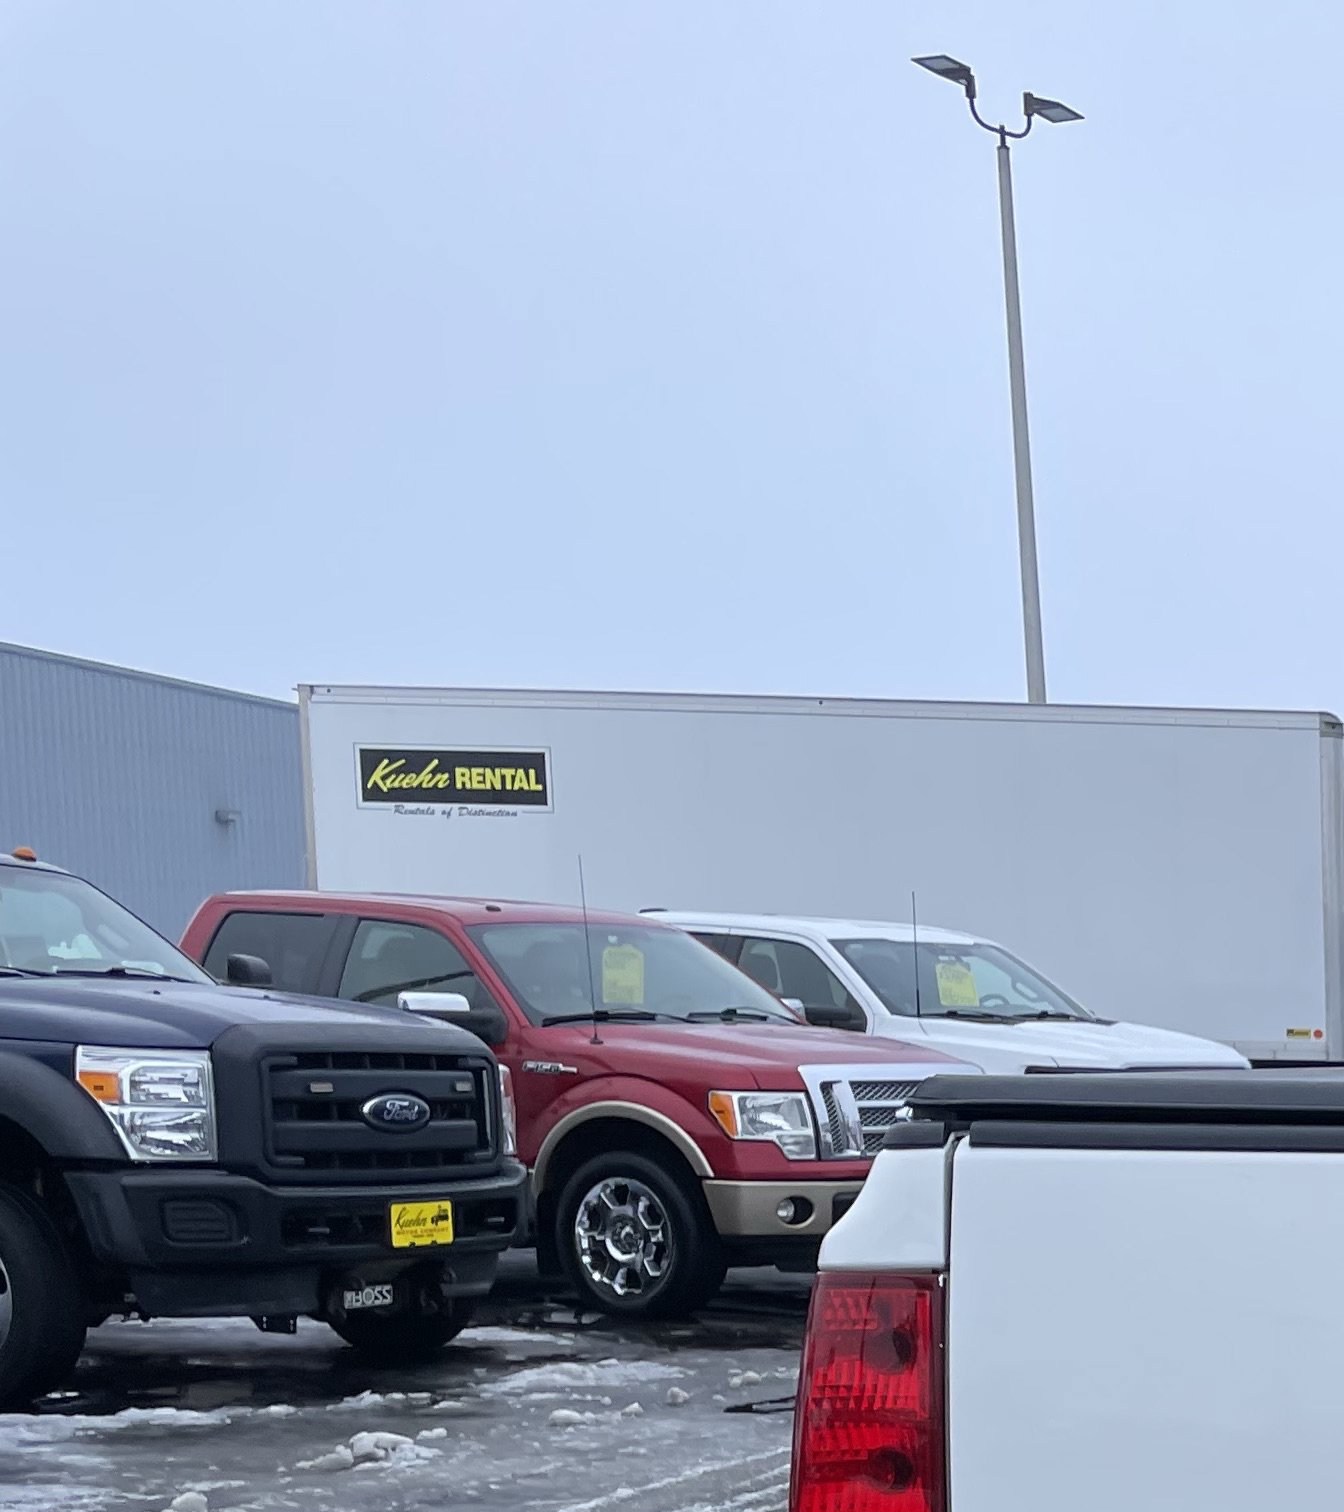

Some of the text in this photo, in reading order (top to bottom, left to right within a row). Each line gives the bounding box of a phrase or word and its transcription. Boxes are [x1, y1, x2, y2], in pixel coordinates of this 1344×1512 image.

[367, 758, 543, 793] Kuehn RENTAL
[393, 804, 435, 816] Rentals
[441, 807, 452, 819] of
[383, 1100, 419, 1121] Ford
